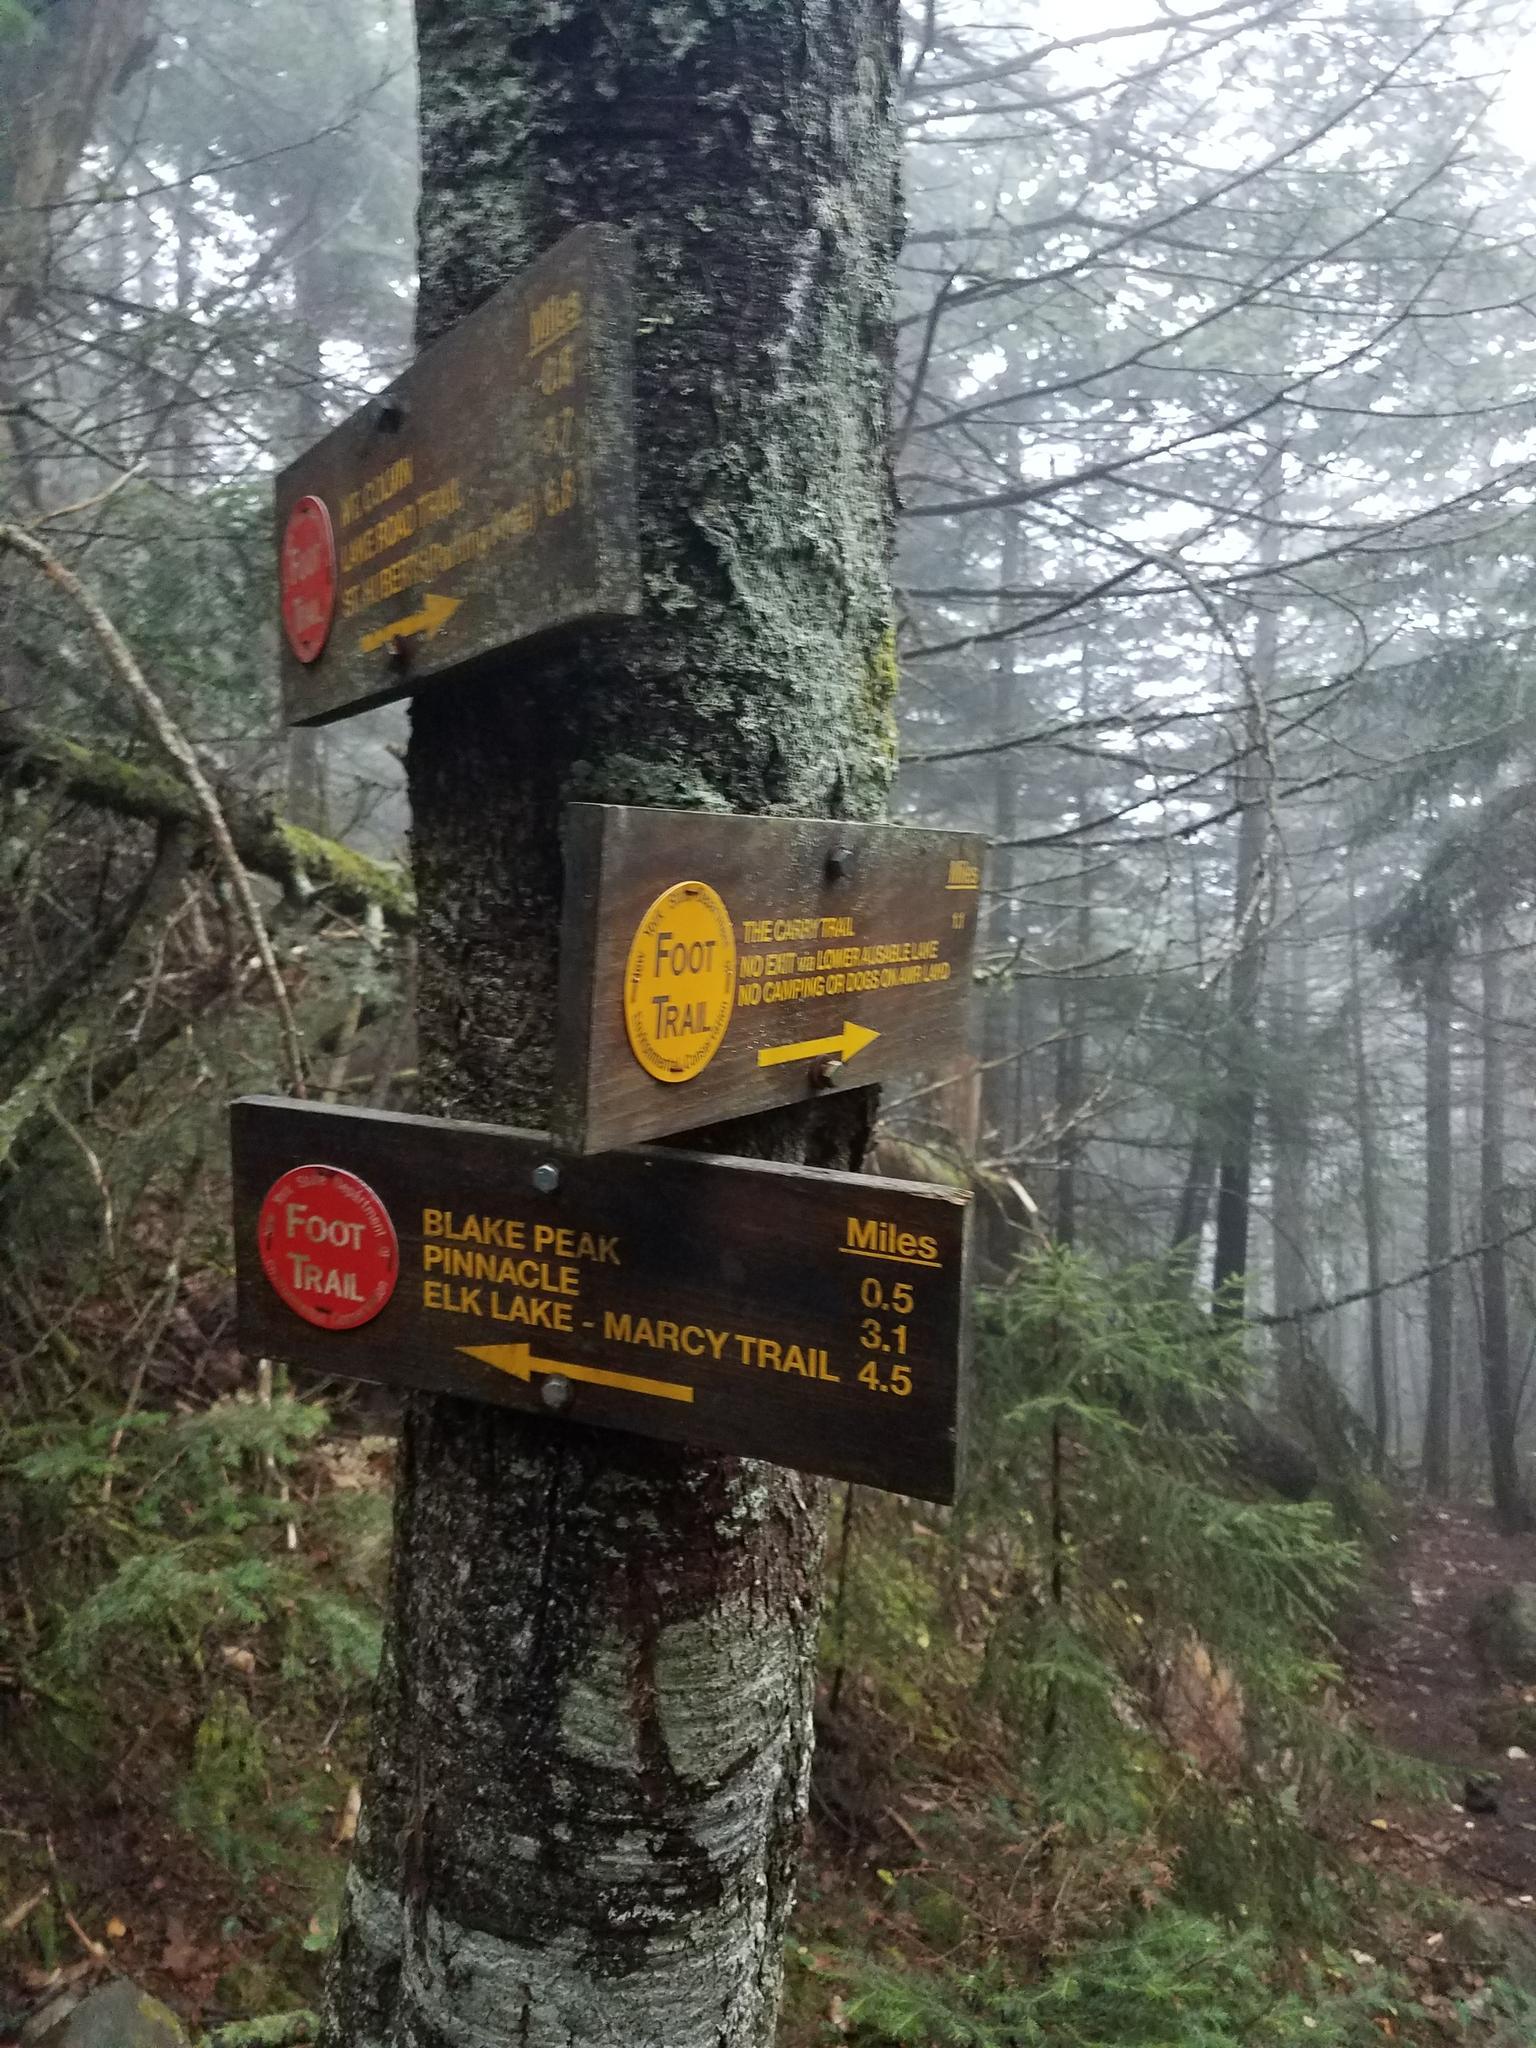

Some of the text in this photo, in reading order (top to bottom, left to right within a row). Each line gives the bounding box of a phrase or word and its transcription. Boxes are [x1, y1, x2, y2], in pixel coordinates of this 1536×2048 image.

[948, 860, 979, 884] Miles
[743, 920, 774, 944] THE
[819, 916, 856, 938] TRAIL
[739, 954, 765, 978] NO
[764, 952, 797, 976] EXIT
[816, 946, 861, 971] LOWER
[911, 940, 939, 960] LAKE
[738, 982, 762, 1007] NO
[763, 975, 826, 1003] CAMPING
[825, 973, 846, 995] OR
[846, 969, 880, 992] DOGS
[423, 1208, 621, 1265] BLAKE PEAK
[847, 1216, 939, 1260] Miles
[423, 1244, 580, 1297] PINNACLE
[860, 1277, 915, 1315] 0.5
[423, 1280, 484, 1316] ELK
[490, 1290, 574, 1333] LAKE
[603, 1311, 729, 1361] MARCY
[735, 1334, 842, 1384] TRAIL
[859, 1318, 908, 1356] 3.1
[857, 1361, 913, 1397] 4.5
